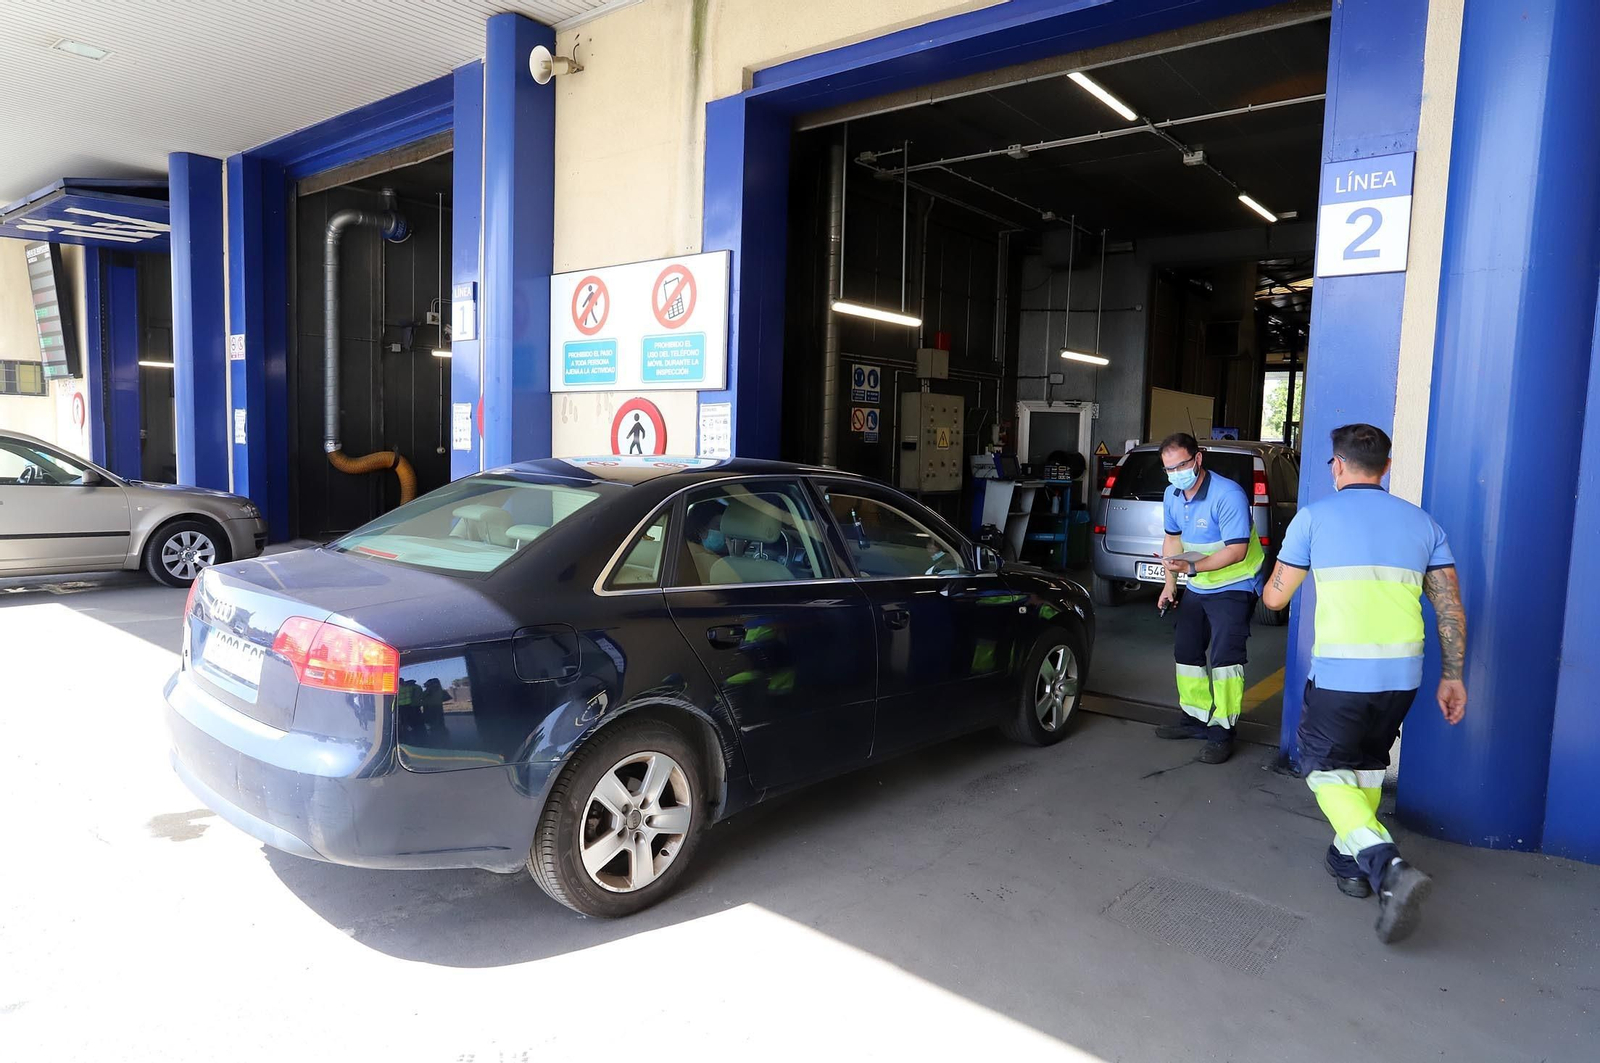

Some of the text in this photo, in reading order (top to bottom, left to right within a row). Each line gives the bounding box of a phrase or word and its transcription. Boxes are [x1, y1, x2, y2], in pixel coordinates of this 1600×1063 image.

[1335, 170, 1397, 193] LÍNEA
[1343, 206, 1383, 261] 2
[460, 305, 467, 335] 1
[600, 349, 613, 357] PASO
[670, 348, 699, 357] TELÉFONO
[647, 358, 664, 367] MÓVIL
[664, 358, 691, 366] DURANTE
[656, 367, 689, 375] INSPECCIÓN
[1147, 565, 1165, 576] 548
